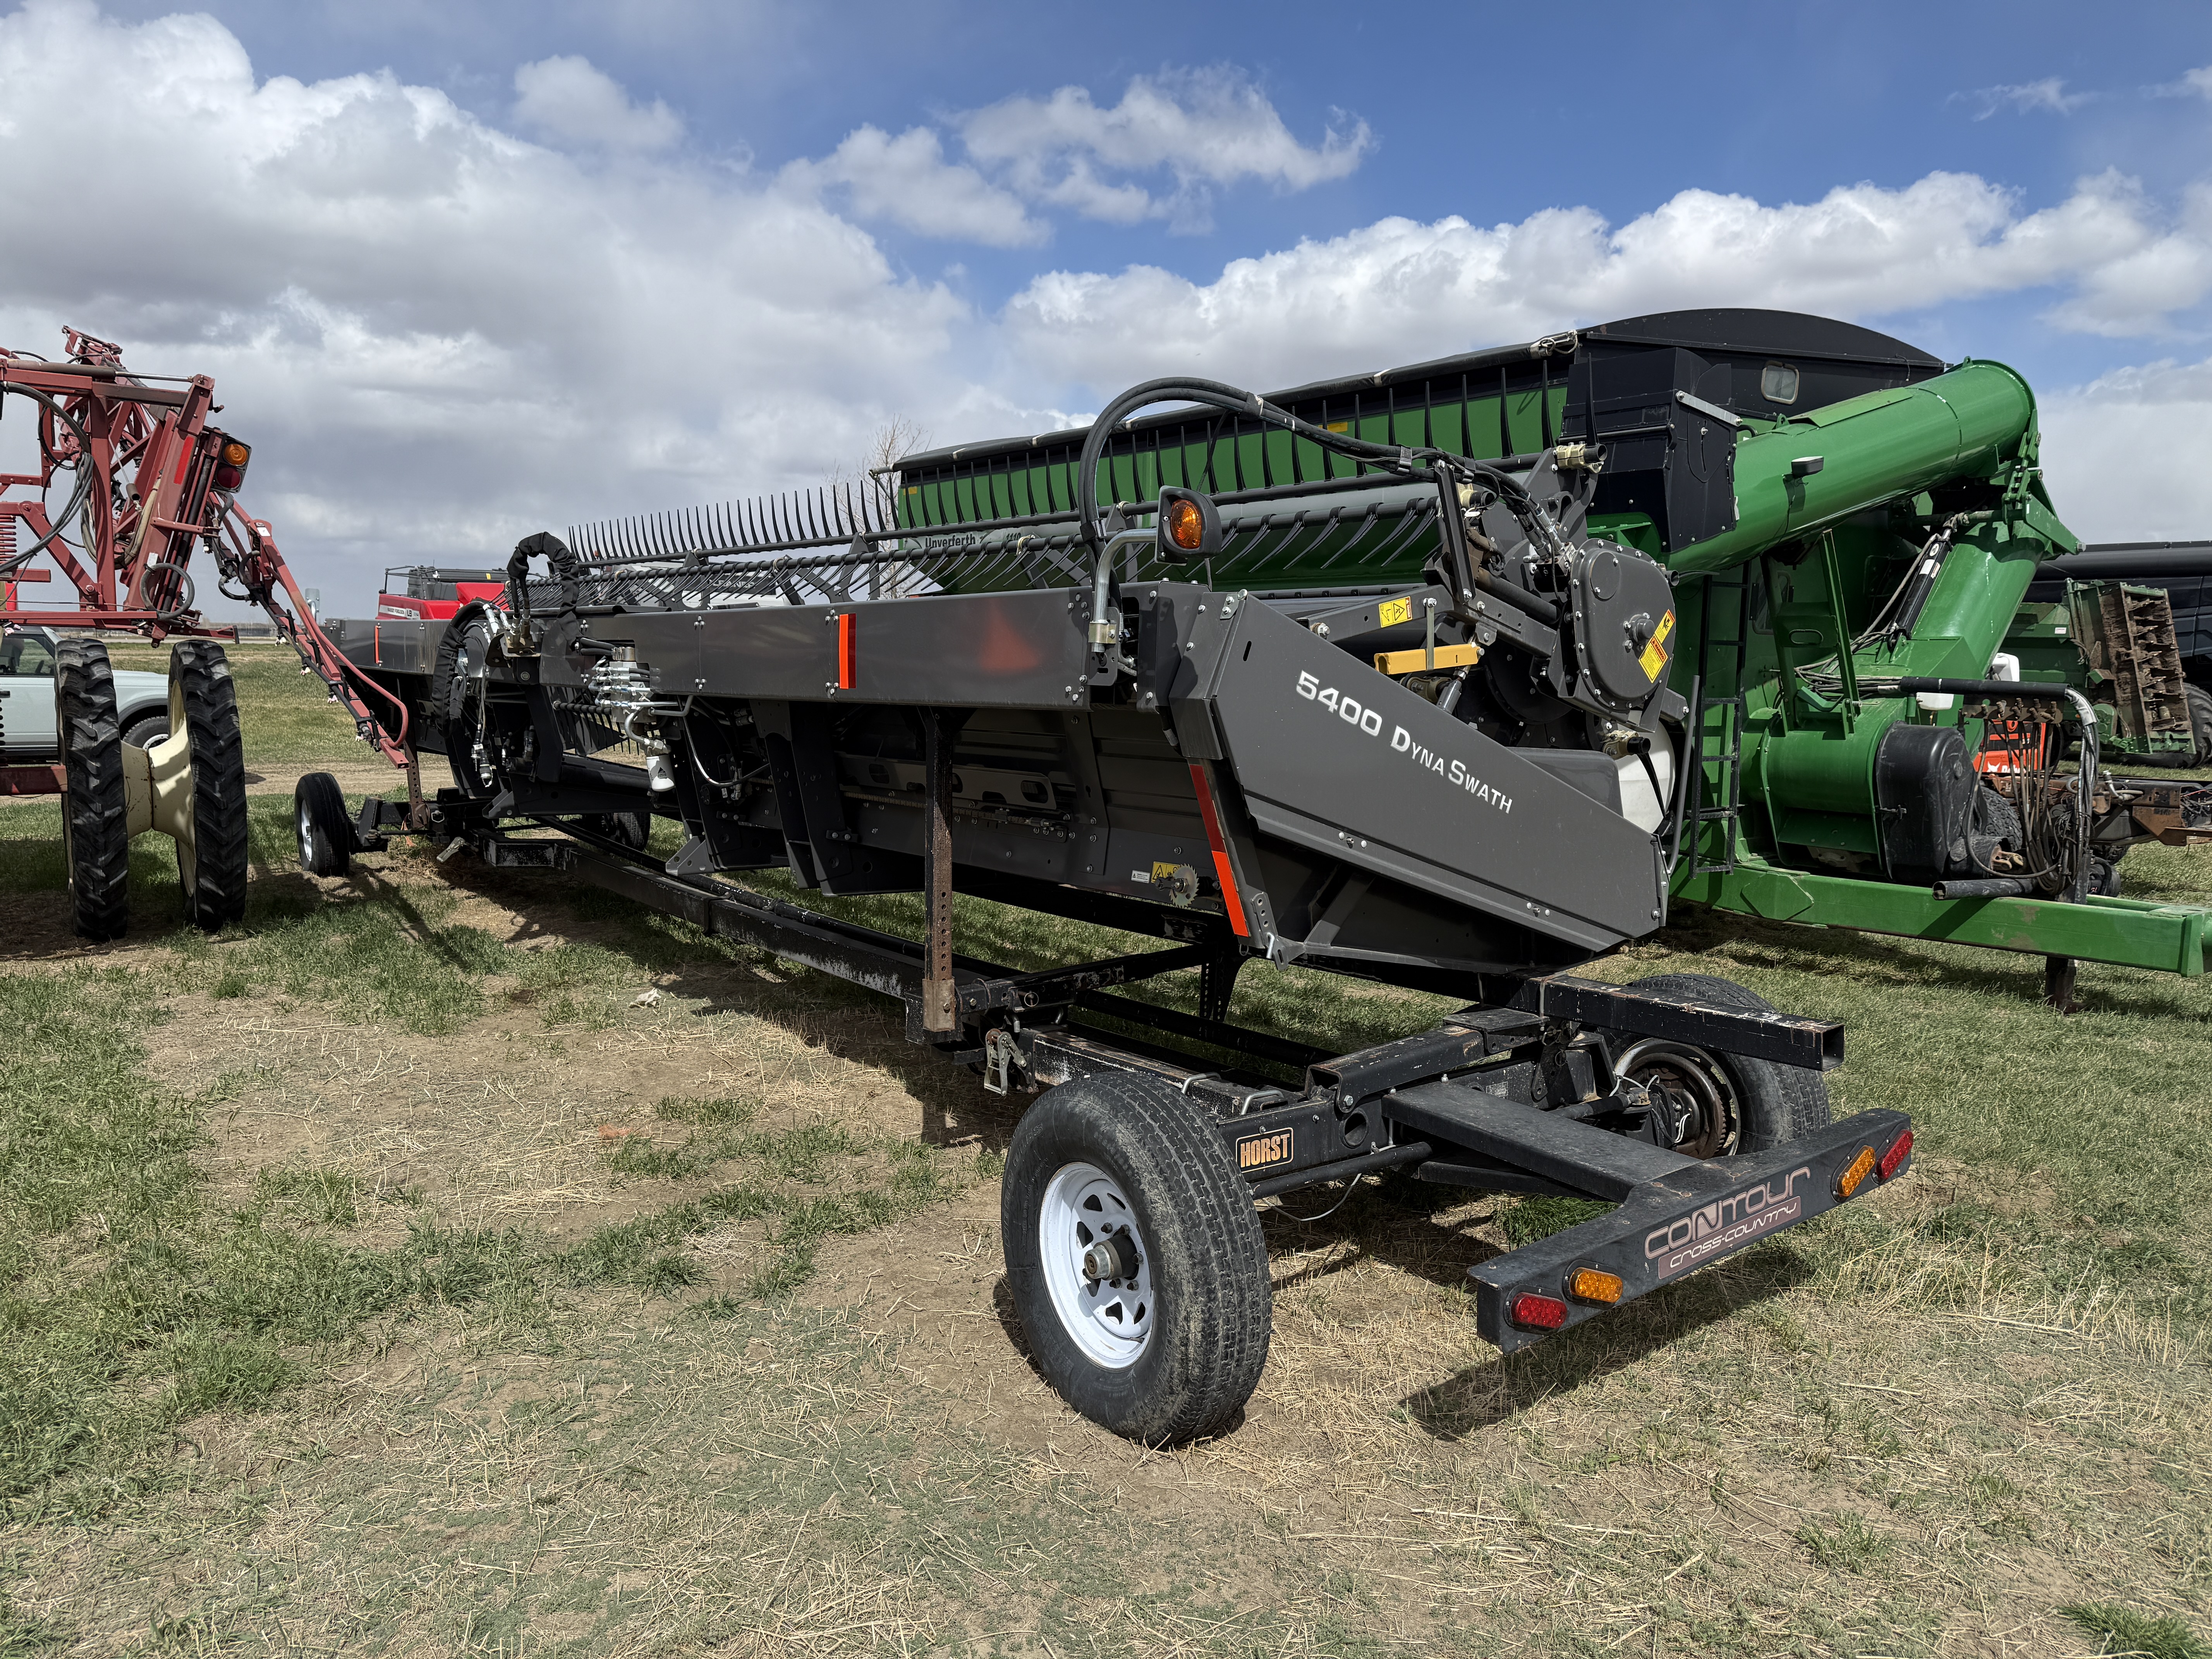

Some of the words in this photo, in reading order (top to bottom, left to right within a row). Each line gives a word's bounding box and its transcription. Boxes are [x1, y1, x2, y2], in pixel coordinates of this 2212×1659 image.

[925, 533, 975, 548] Unverferth
[1296, 670, 1382, 737] 5400
[1240, 1133, 1290, 1168] HORST
[1644, 1166, 1810, 1259] CONTOUR
[1670, 1202, 1797, 1268] CROSS-COUNTRY
